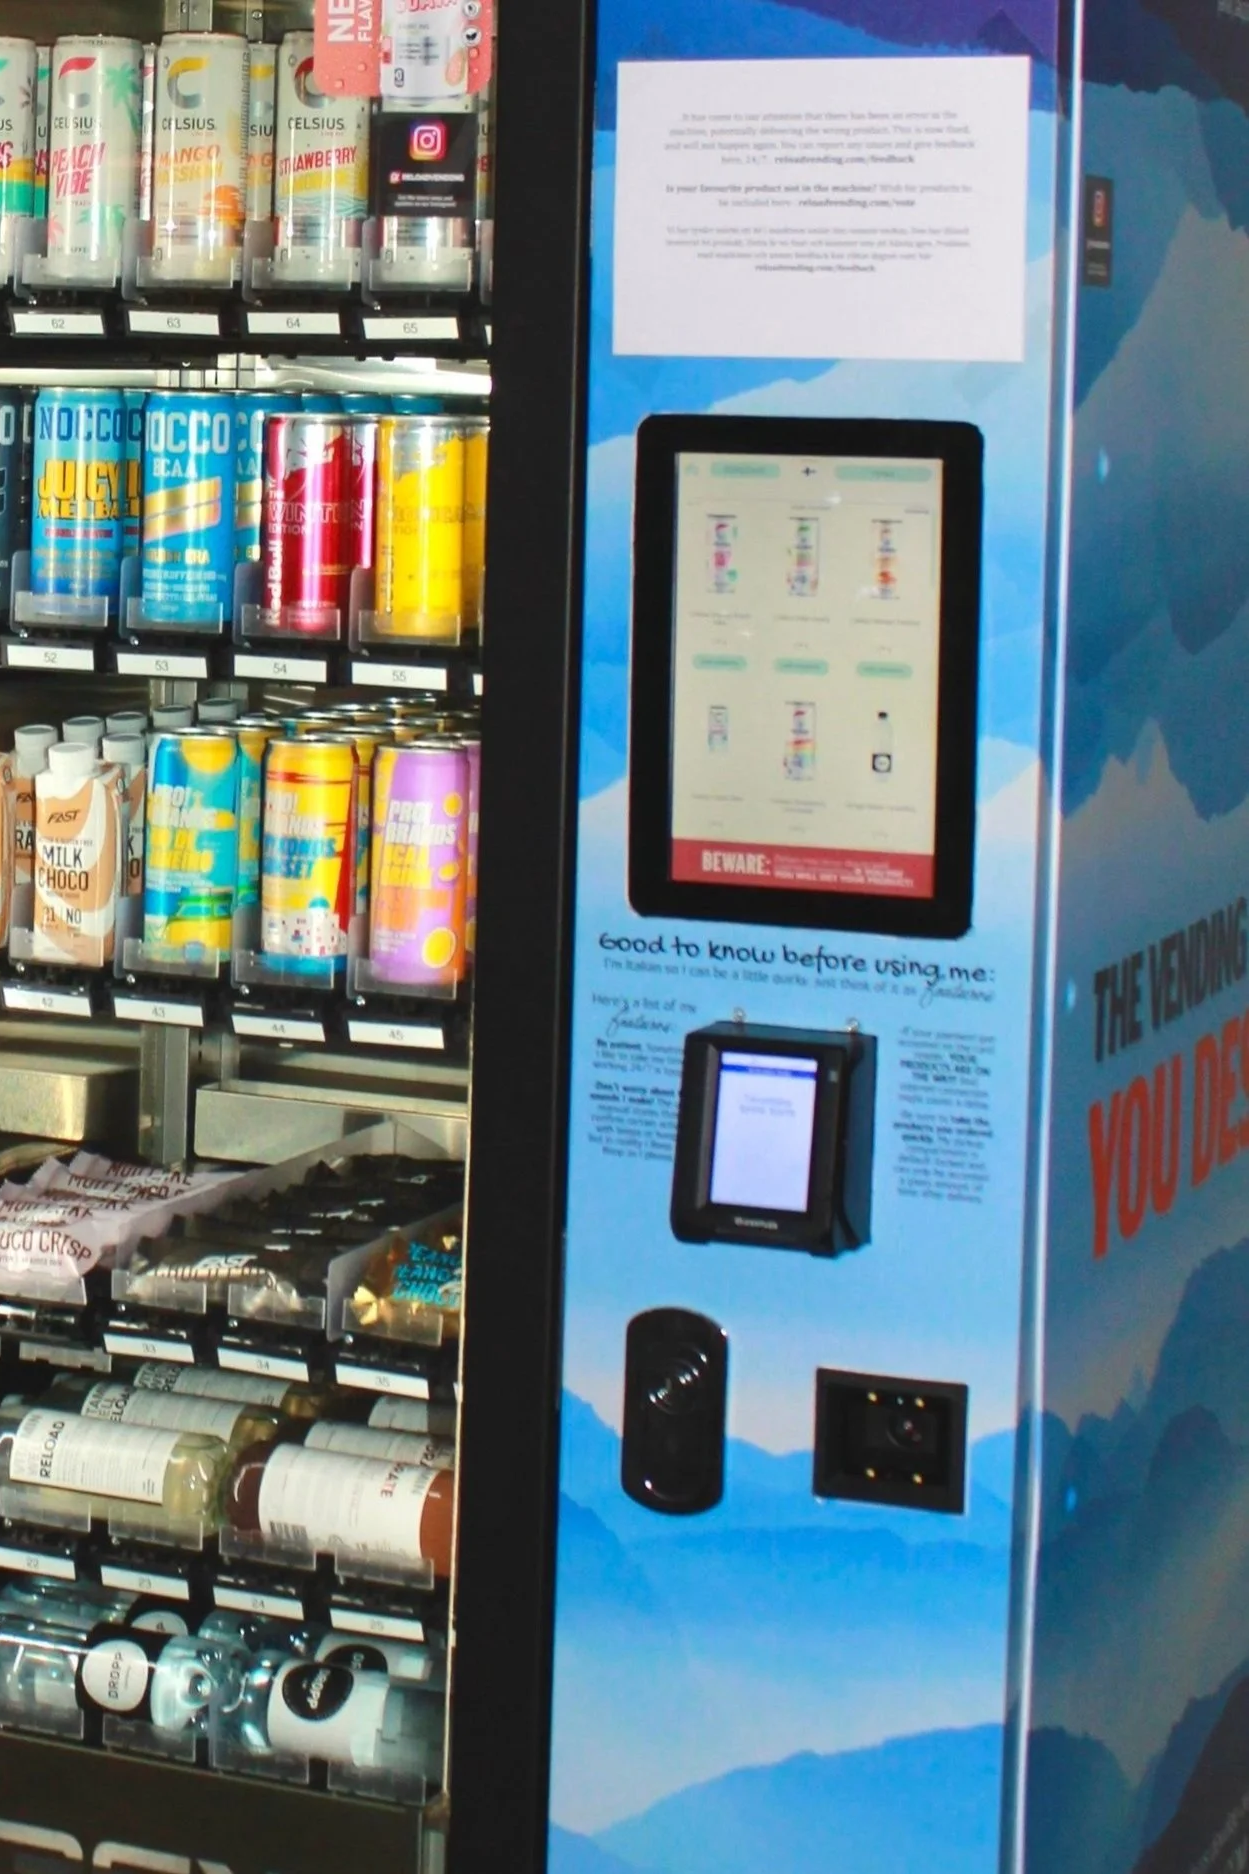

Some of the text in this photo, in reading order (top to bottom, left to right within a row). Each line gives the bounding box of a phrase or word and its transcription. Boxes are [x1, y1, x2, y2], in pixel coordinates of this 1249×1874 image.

[54, 117, 102, 130] CELSIUS
[162, 118, 216, 131] CELSIUS
[288, 117, 345, 130] CELSIUS
[51, 142, 106, 169] PEACH
[158, 144, 221, 165] MANGO
[278, 146, 358, 177] STRAWBERRY
[56, 169, 94, 199] VIBE
[51, 318, 65, 329] 62
[166, 318, 181, 329] 63
[286, 318, 301, 329] 64
[402, 323, 418, 334] 65
[37, 404, 125, 443] NOCCO
[152, 457, 199, 479] BCAA
[37, 459, 121, 500] JUICY
[268, 502, 341, 524] WINT
[44, 652, 58, 664] 52
[155, 660, 169, 672] 53
[272, 662, 288, 674] 54
[392, 671, 407, 683] 55
[47, 809, 81, 824] FAST
[42, 843, 83, 869] MILK
[701, 850, 771, 876] BEWARE:
[38, 868, 89, 892] CHOCO
[65, 906, 82, 925] NO
[599, 931, 995, 986] Good to know before using me:
[1093, 894, 1248, 1064] THE VENDING
[41, 997, 54, 1008] 42
[152, 1005, 166, 1018] 43
[271, 1023, 286, 1034] 44
[388, 1029, 404, 1041] 45
[1088, 1053, 1183, 1261] YOU
[38, 1230, 92, 1263] CRISP
[256, 1359, 270, 1370] 34
[40, 1420, 65, 1479] RELOAD
[26, 1558, 39, 1568] 22
[139, 1578, 152, 1588] 23
[252, 1599, 265, 1609] 24
